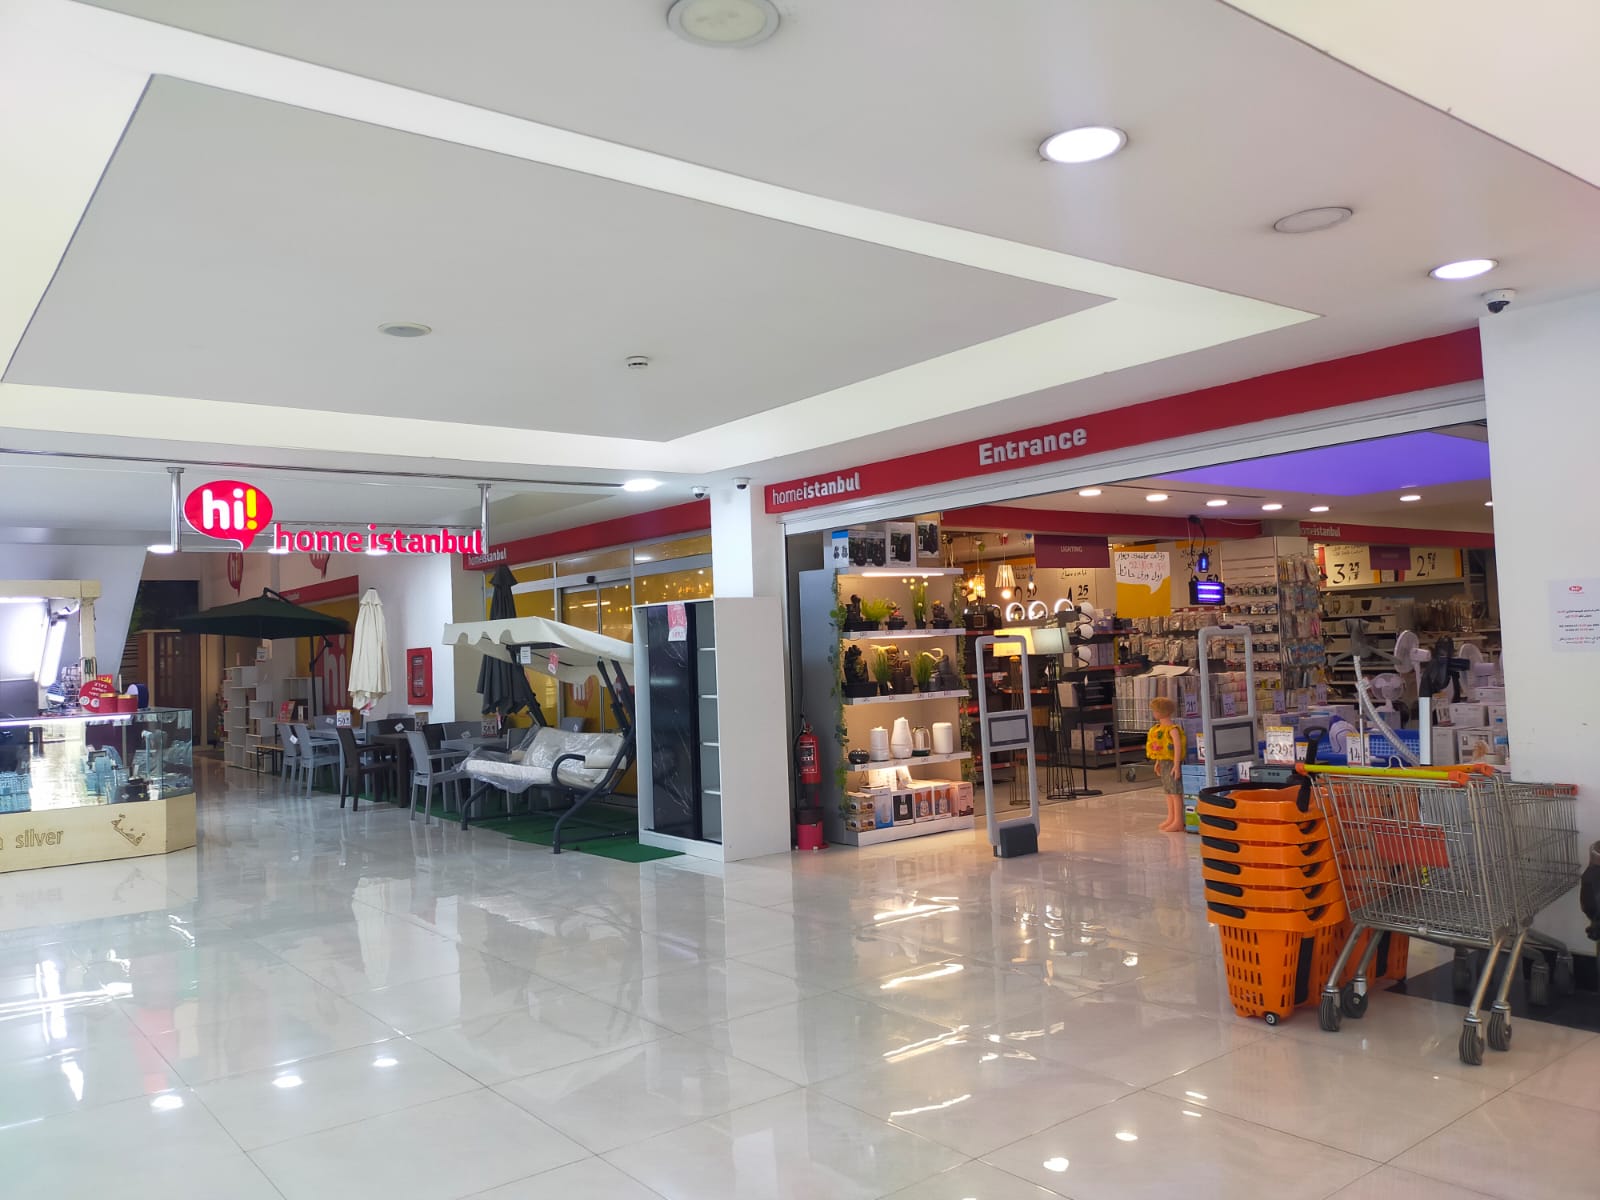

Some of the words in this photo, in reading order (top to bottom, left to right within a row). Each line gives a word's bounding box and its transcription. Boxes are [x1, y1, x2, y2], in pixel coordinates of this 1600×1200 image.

[979, 427, 1087, 466] Entrance
[772, 472, 860, 505] homeistanbul
[202, 487, 258, 531] hi!
[274, 522, 363, 553] home
[367, 523, 484, 555] istanbul
[15, 828, 64, 849] silver
